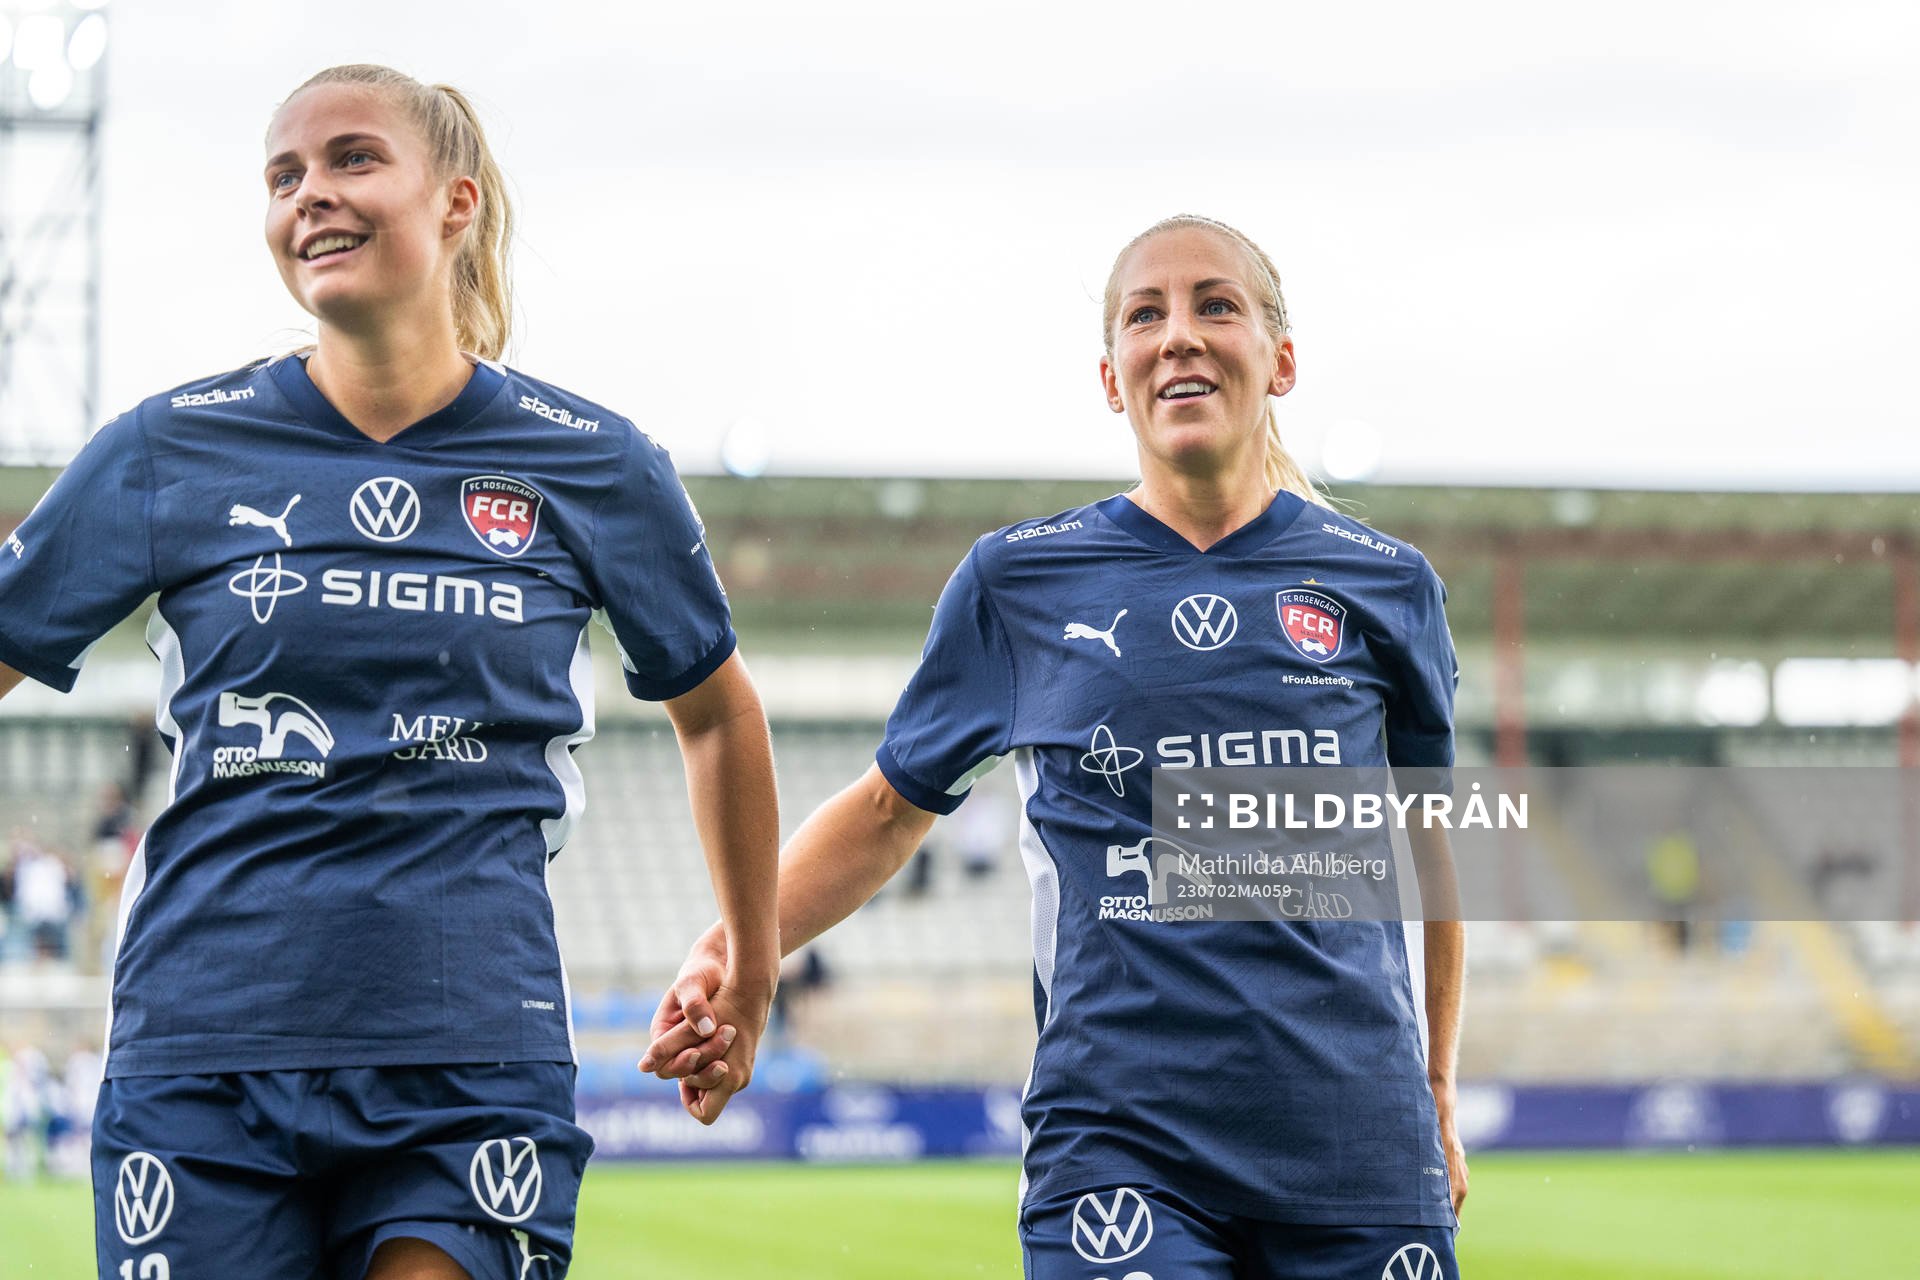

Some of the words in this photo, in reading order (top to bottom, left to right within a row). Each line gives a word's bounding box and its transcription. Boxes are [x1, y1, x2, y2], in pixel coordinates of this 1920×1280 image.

[170, 386, 255, 408] stadium
[518, 395, 600, 433] stadium
[472, 496, 529, 522] FCR
[1005, 519, 1083, 543] stadium
[1321, 523, 1398, 558] stadium
[1282, 595, 1293, 603] FC
[1294, 595, 1340, 617] ROSENGÅRD
[1287, 608, 1334, 638] FCR
[213, 747, 257, 763] OTTO
[213, 760, 326, 778] MAGNUSSON
[1100, 896, 1146, 910] OTTO
[1278, 882, 1352, 919] GÅRD
[1099, 904, 1213, 923] MAGNUSSON
